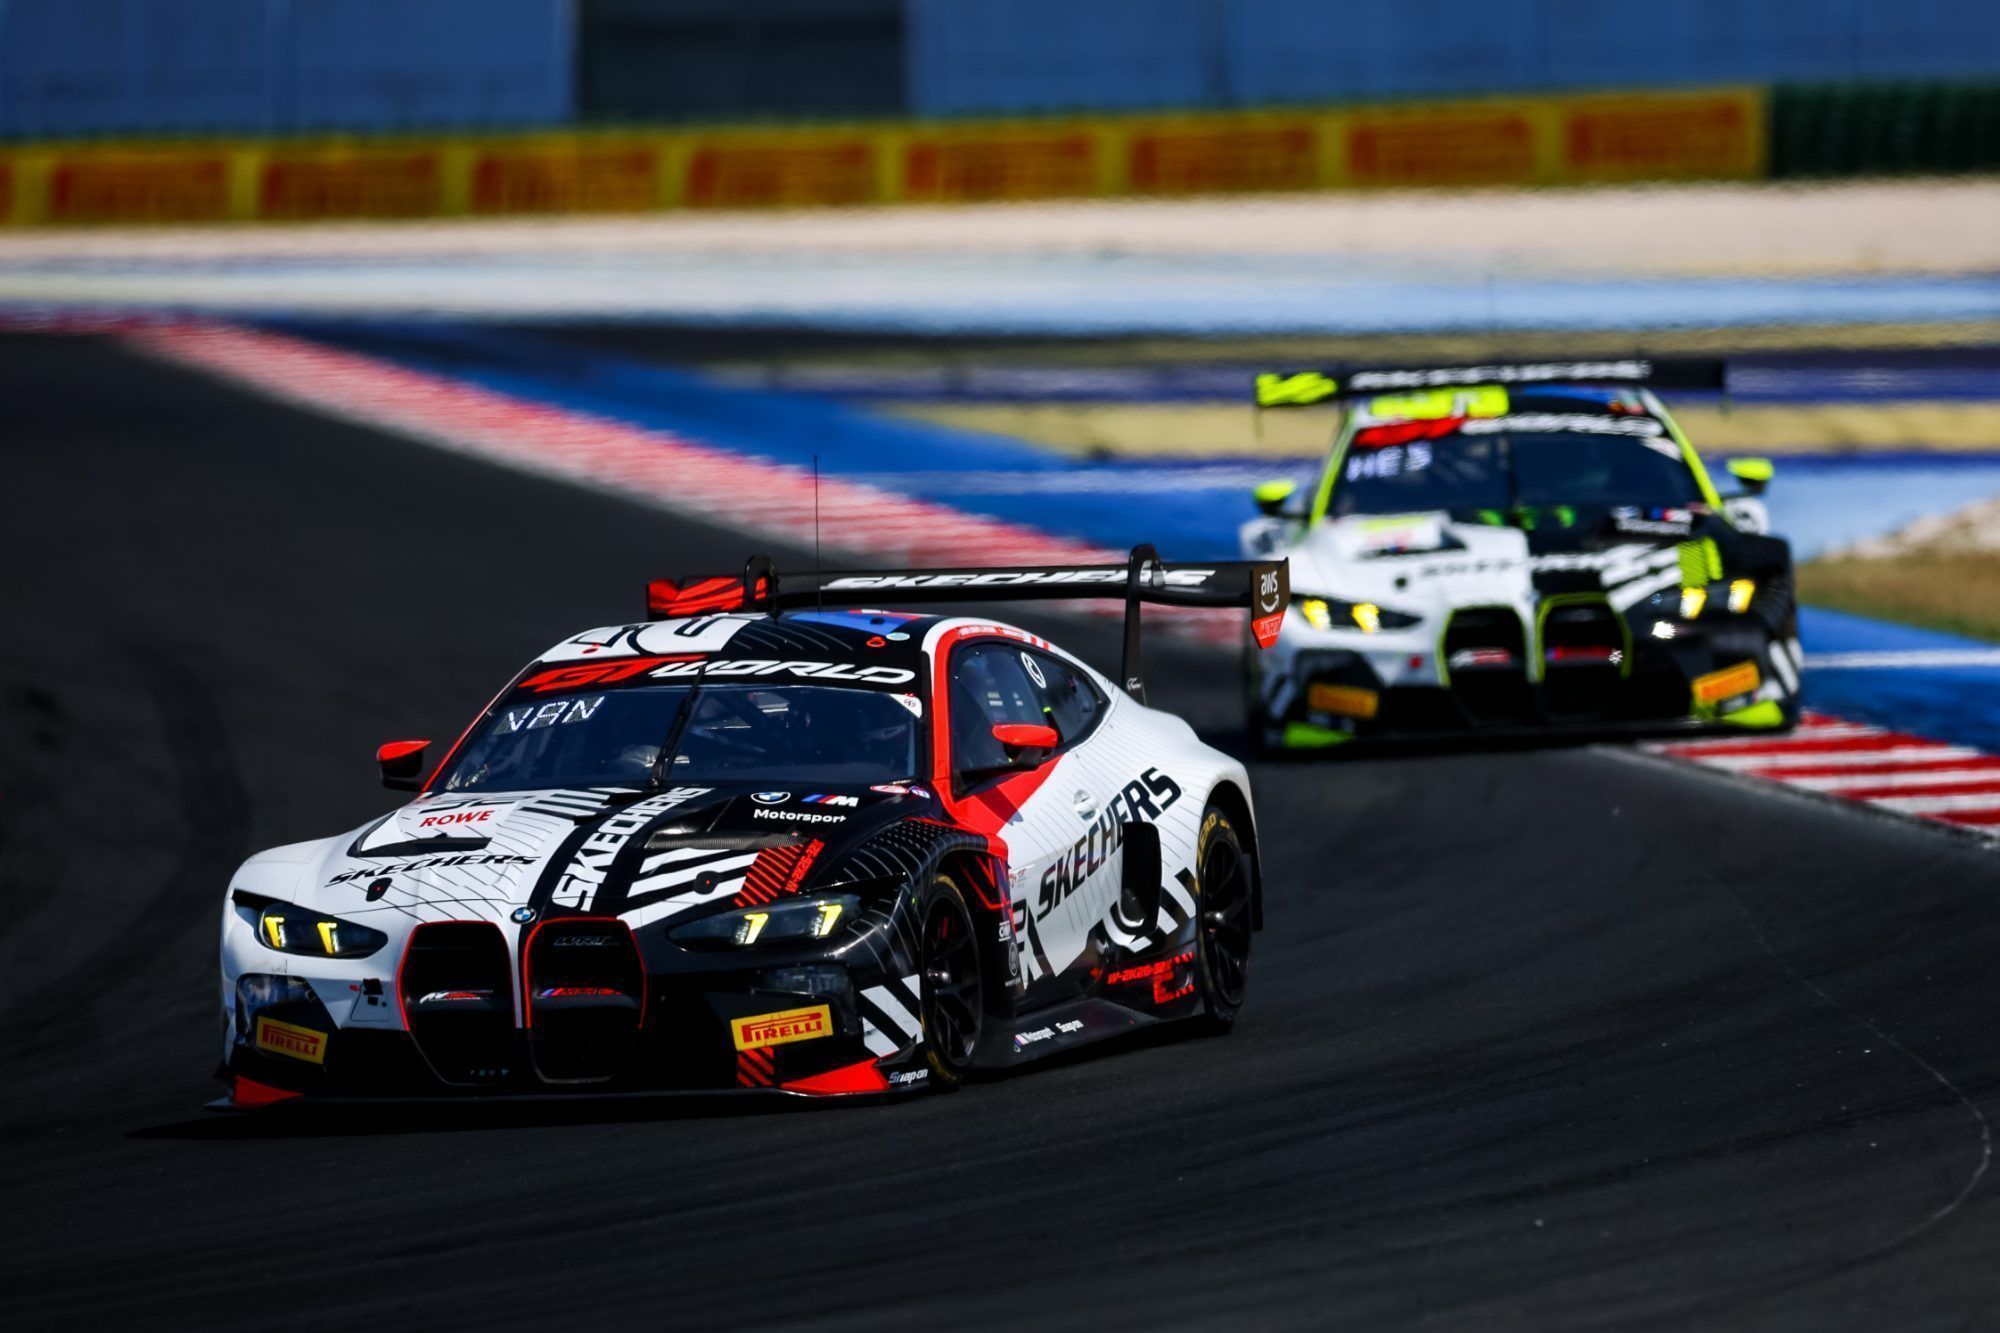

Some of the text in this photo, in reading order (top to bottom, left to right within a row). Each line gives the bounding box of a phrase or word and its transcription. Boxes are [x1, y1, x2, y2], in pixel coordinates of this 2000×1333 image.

[1261, 571, 1278, 596] aws
[518, 654, 916, 693] GT WORLD
[507, 696, 605, 732] VAN
[418, 810, 495, 828] ROWE
[753, 808, 847, 824] Motorsport
[552, 786, 716, 912] SKECHERS
[1036, 766, 1182, 923] SKECHERS
[324, 854, 541, 888] SKECHERS
[262, 1023, 320, 1056] PIRELLI
[741, 1012, 822, 1044] PIRELLI
[888, 1068, 928, 1084] Snap-on
